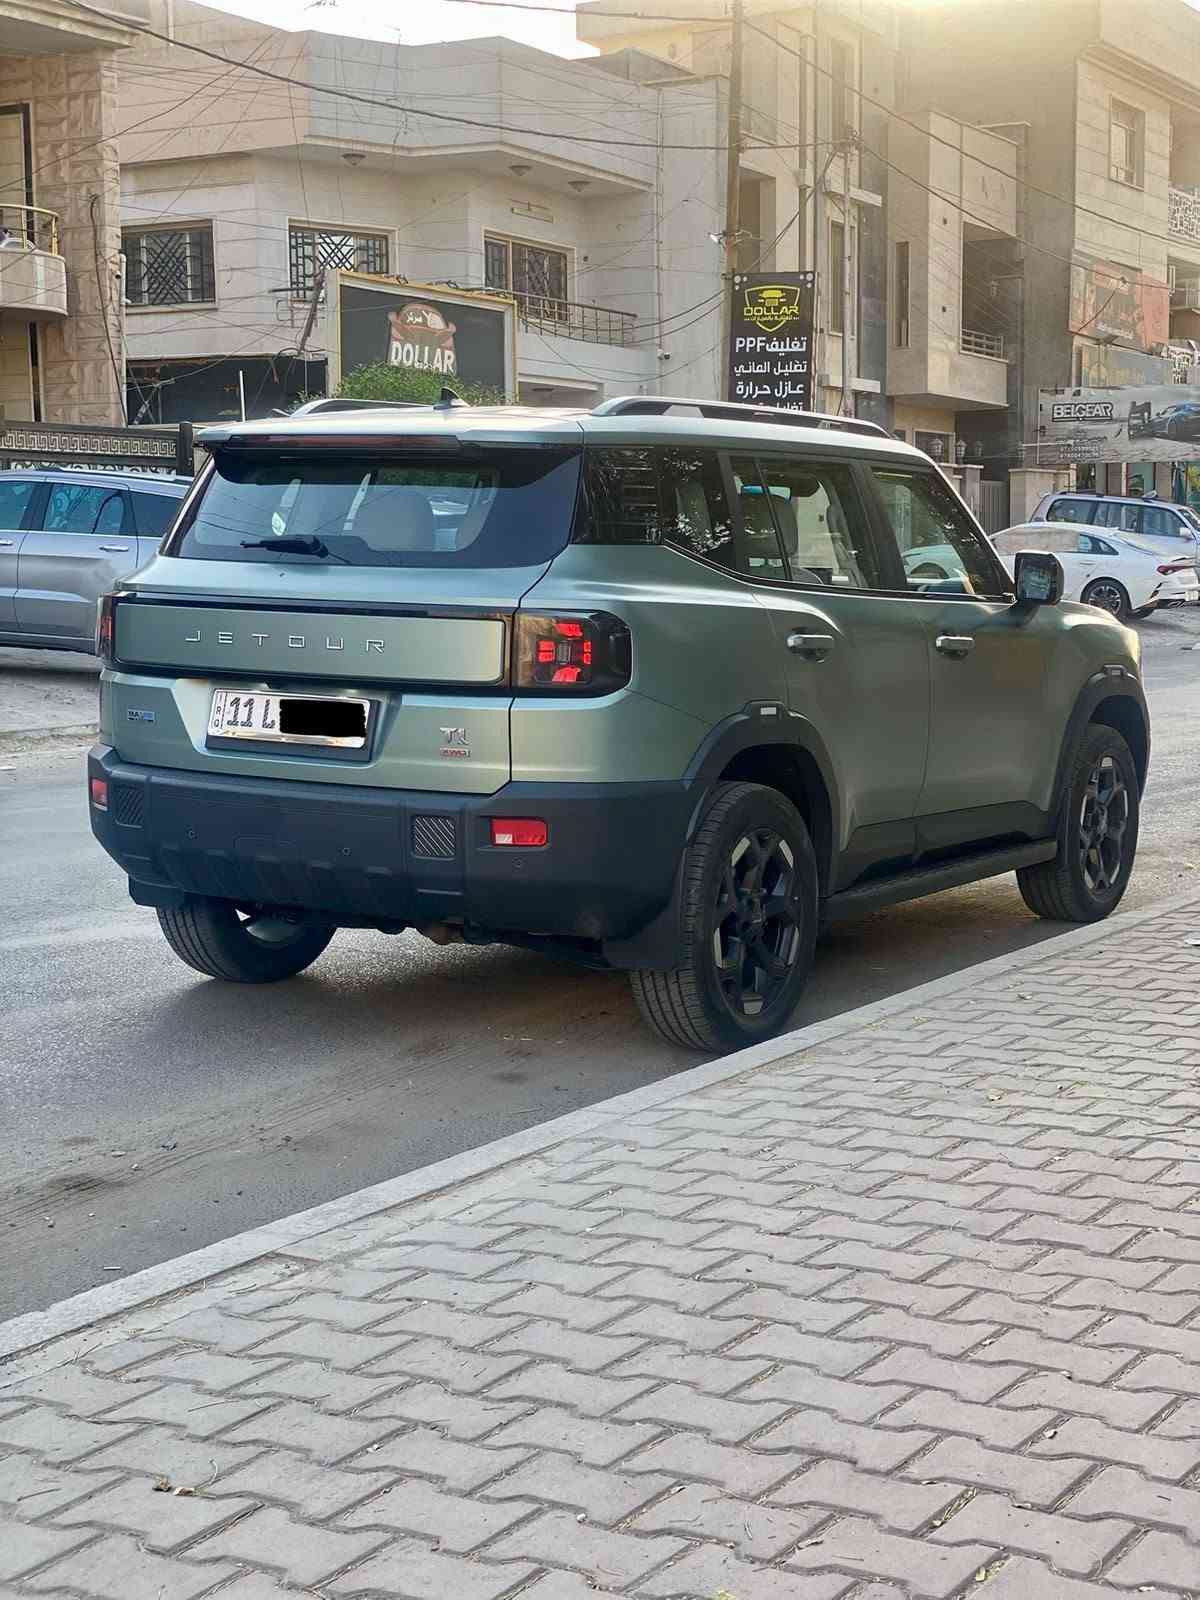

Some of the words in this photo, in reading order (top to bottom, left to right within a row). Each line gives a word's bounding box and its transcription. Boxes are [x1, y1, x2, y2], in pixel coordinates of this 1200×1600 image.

[744, 306, 799, 316] DOLLAR
[736, 337, 766, 352] PPF
[390, 340, 457, 374] DOLLAR
[736, 381, 771, 398] حرارة
[775, 381, 804, 398] عازل
[1053, 403, 1113, 418] BELGEAR
[185, 630, 385, 653] JETOUR
[227, 697, 254, 728] 11
